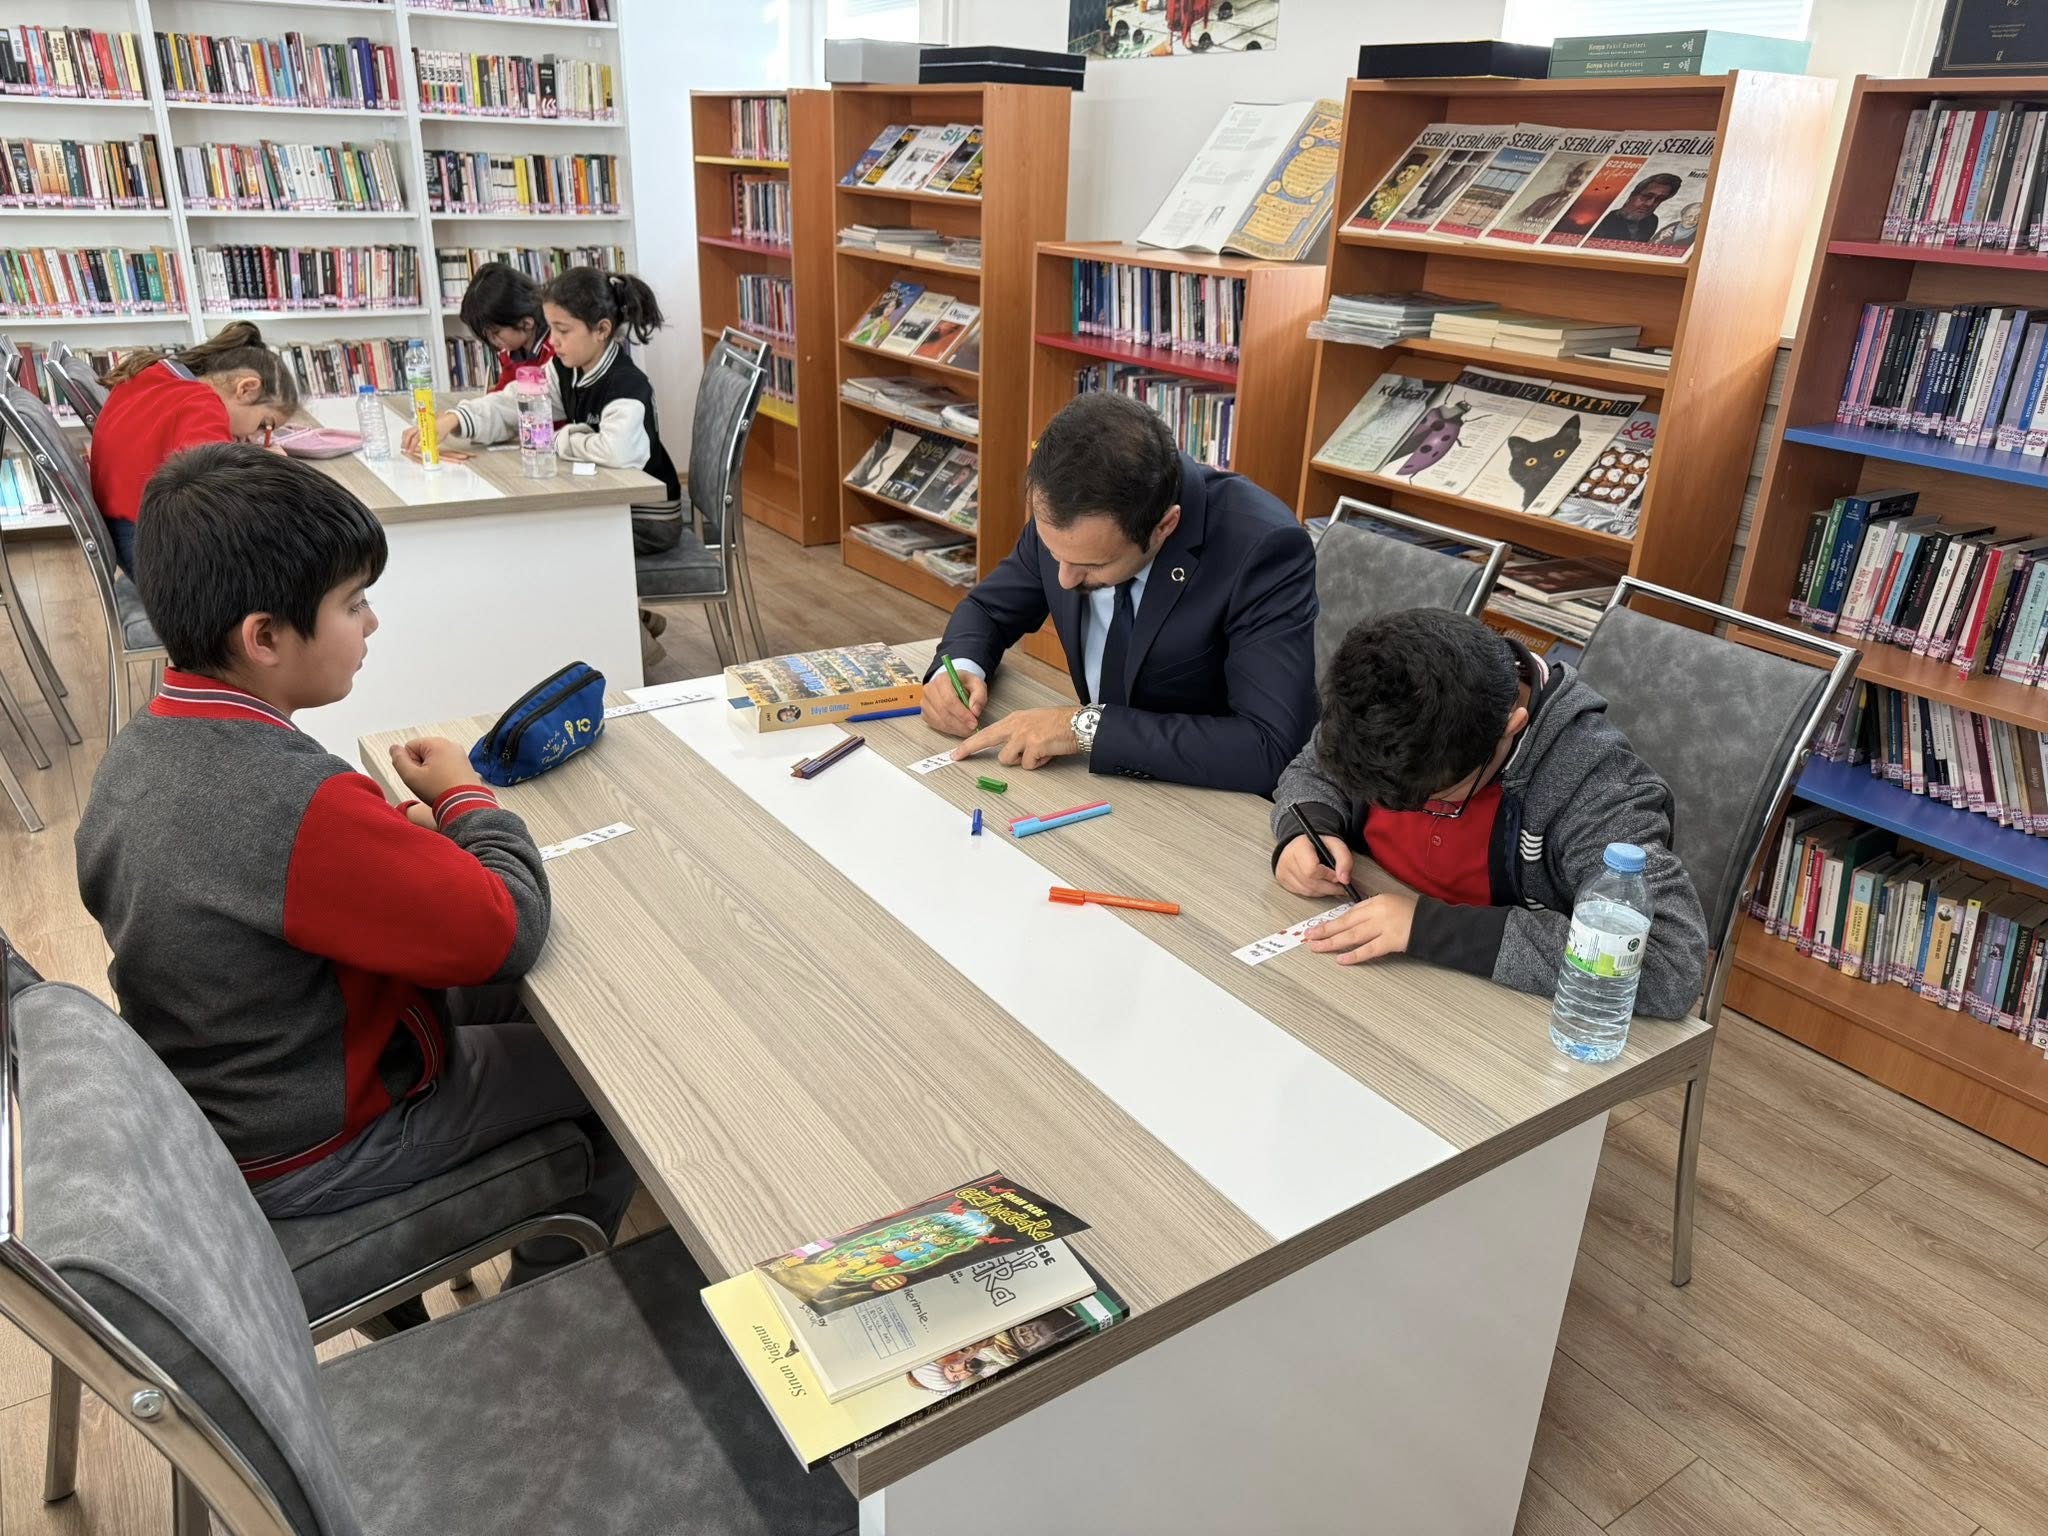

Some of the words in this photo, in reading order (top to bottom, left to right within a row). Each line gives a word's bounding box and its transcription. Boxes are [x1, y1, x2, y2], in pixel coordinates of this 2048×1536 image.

[1546, 391, 1611, 411] KAYIT
[1615, 402, 1631, 415] 10
[751, 1323, 786, 1365] Yağmur
[779, 1364, 807, 1398] Sinan
[828, 1446, 852, 1462] Sinan
[853, 1430, 883, 1450] Yağmur
